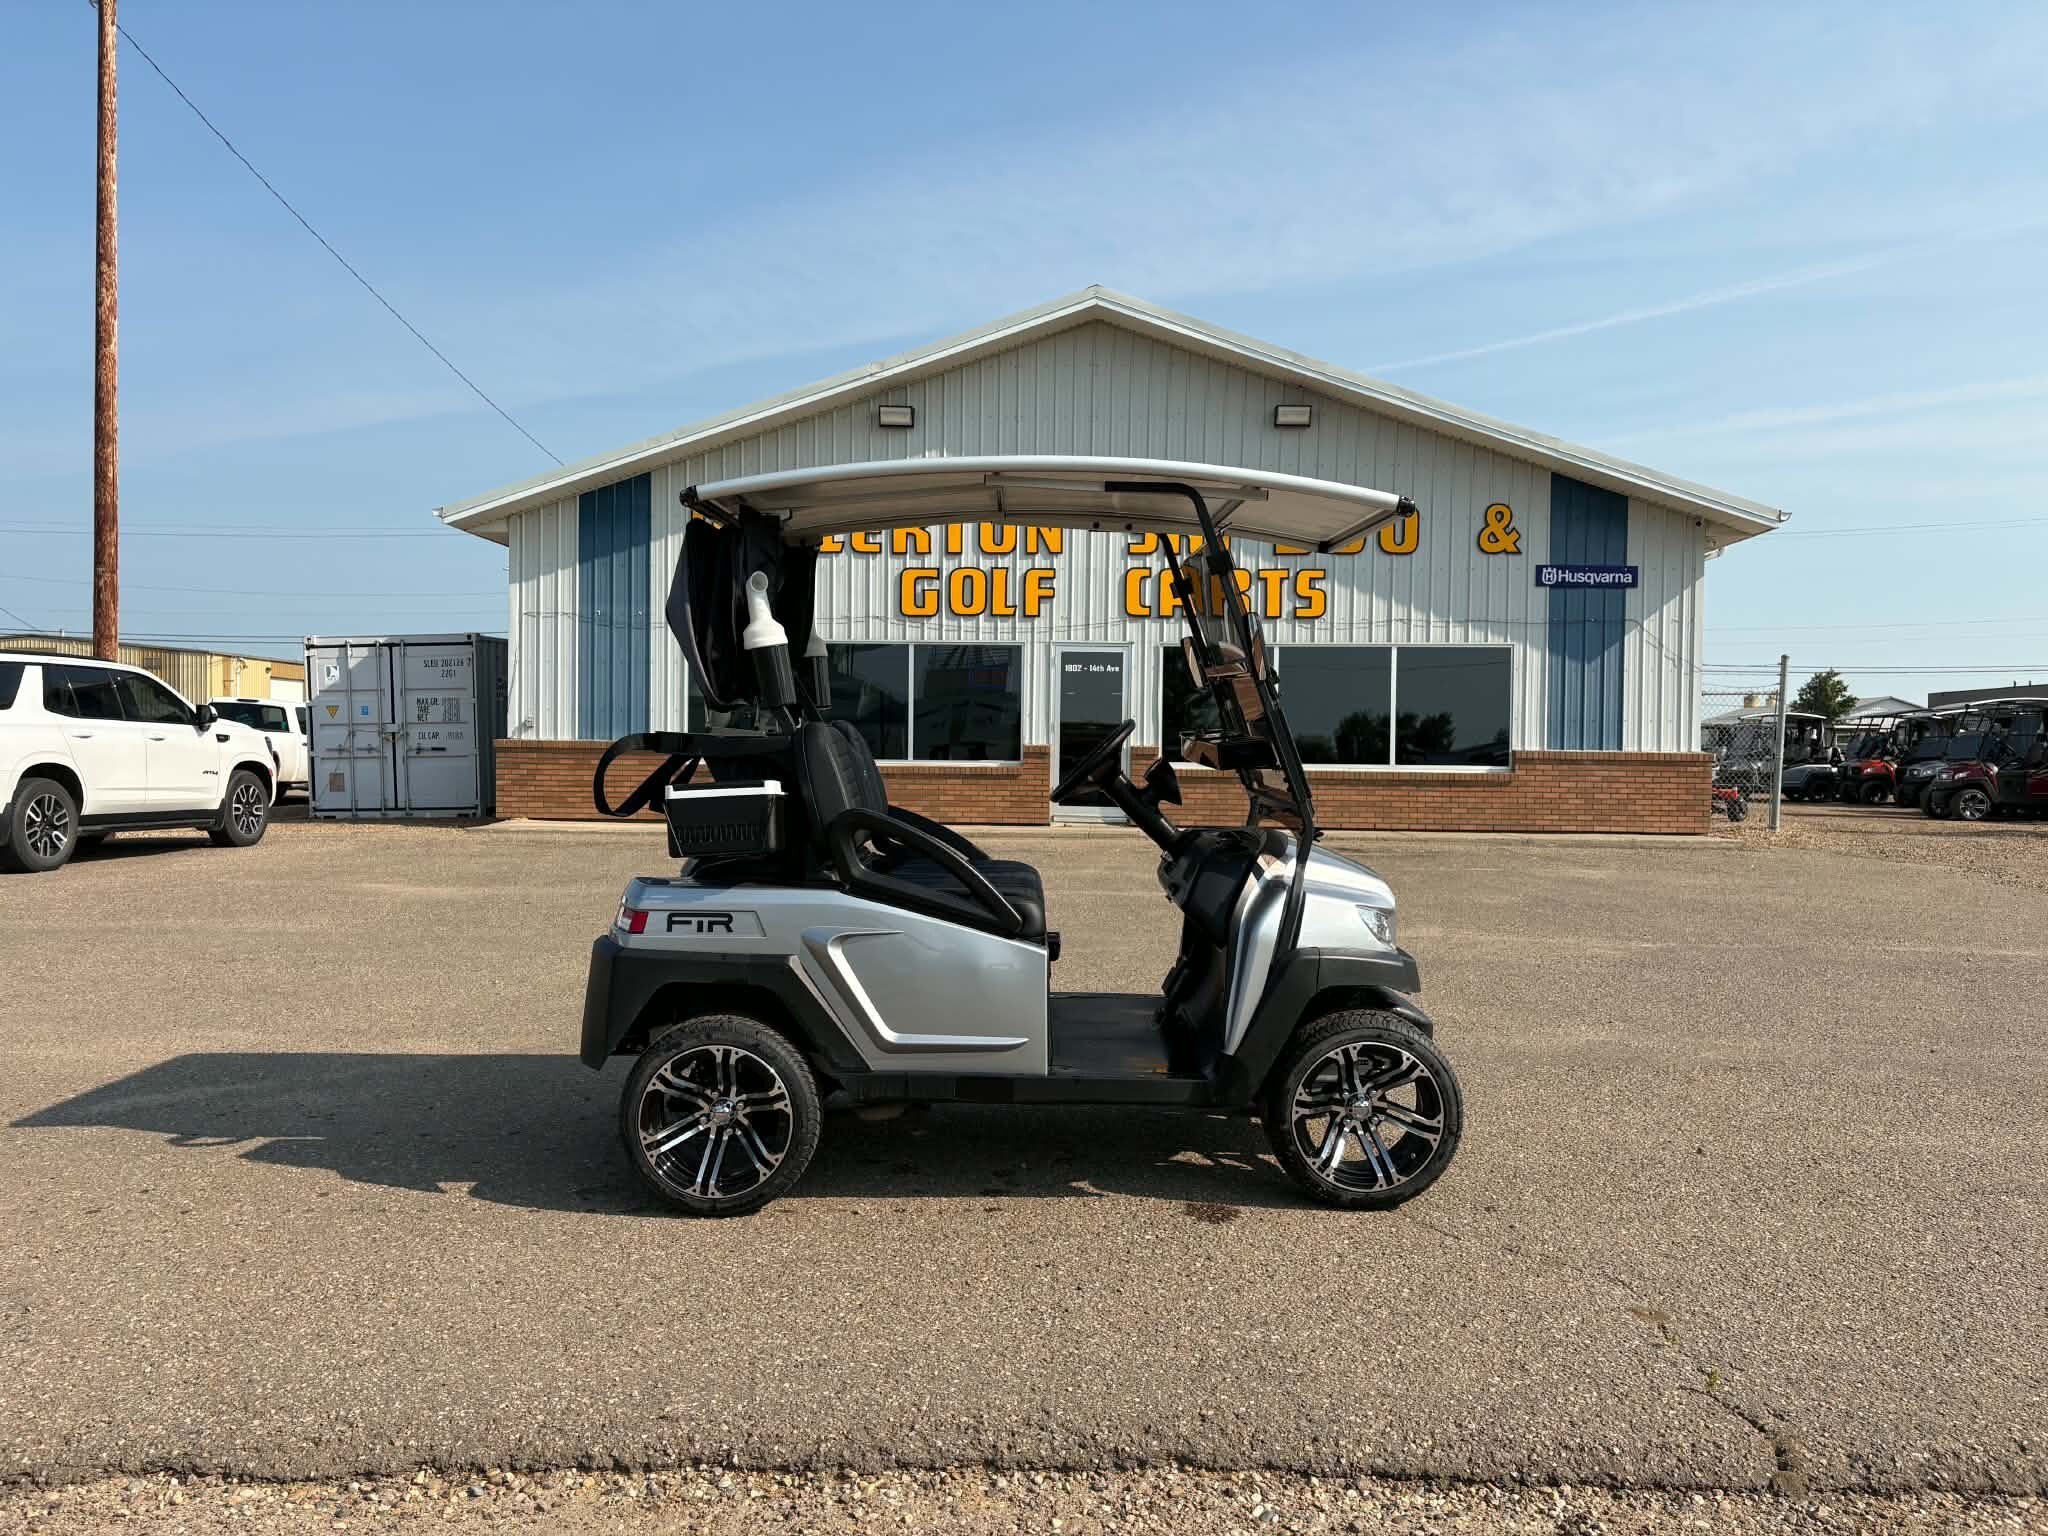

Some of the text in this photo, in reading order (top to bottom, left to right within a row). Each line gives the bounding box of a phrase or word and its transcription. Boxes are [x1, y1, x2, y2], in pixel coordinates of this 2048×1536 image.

[1477, 503, 1522, 555] &
[900, 567, 1056, 617] GOLF
[1125, 566, 1327, 619] CARTS
[1558, 569, 1633, 585] Husqvarna
[1089, 664, 1104, 672] 14th
[1106, 664, 1120, 672] Ave
